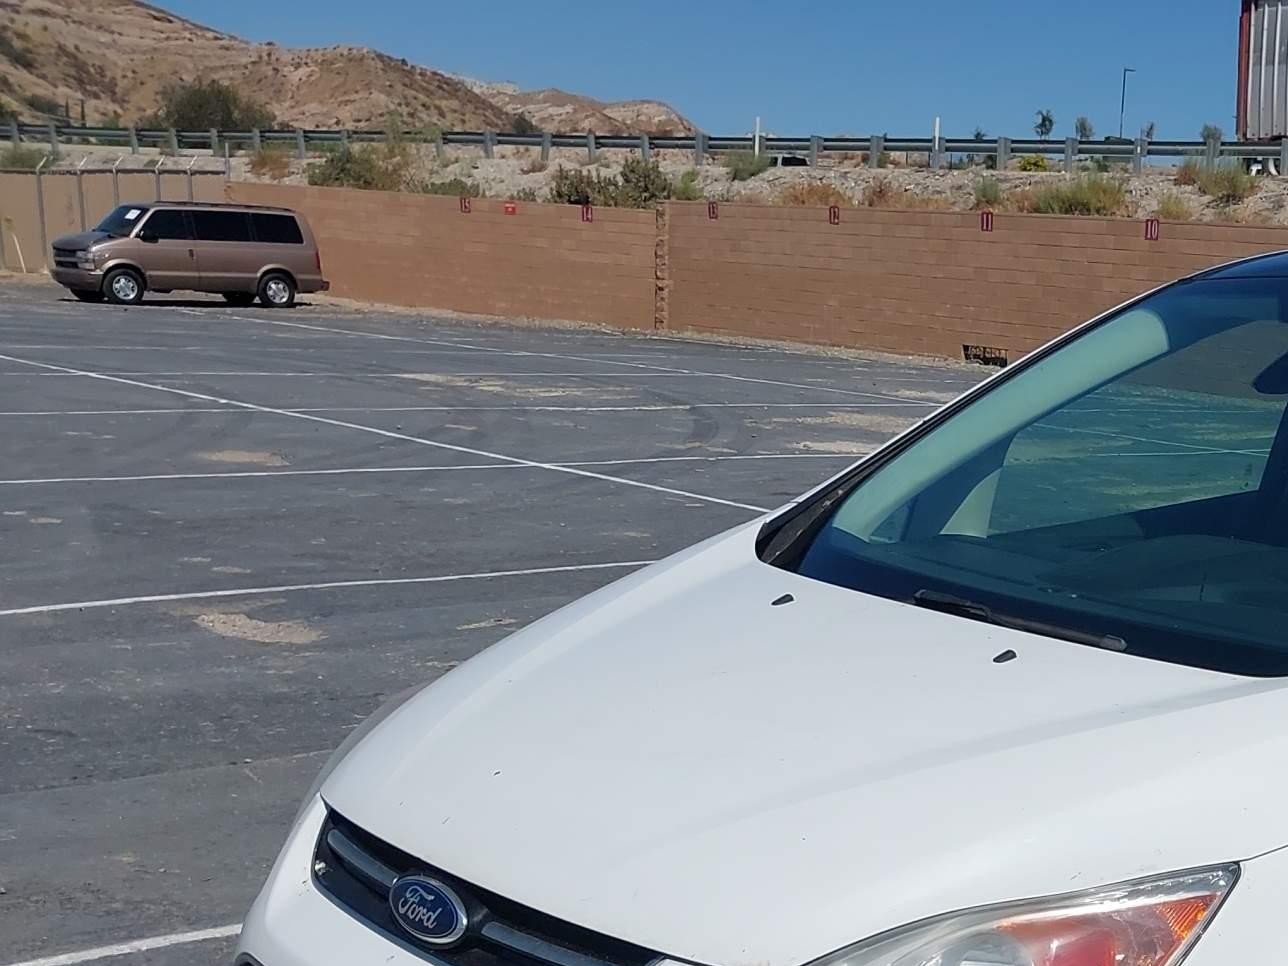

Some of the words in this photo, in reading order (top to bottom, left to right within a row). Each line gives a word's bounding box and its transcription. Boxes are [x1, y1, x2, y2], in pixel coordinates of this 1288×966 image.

[461, 199, 471, 212] 15
[583, 206, 592, 221] 14
[983, 213, 992, 231] 11
[1146, 220, 1158, 239] 10
[398, 885, 443, 929] Ford
